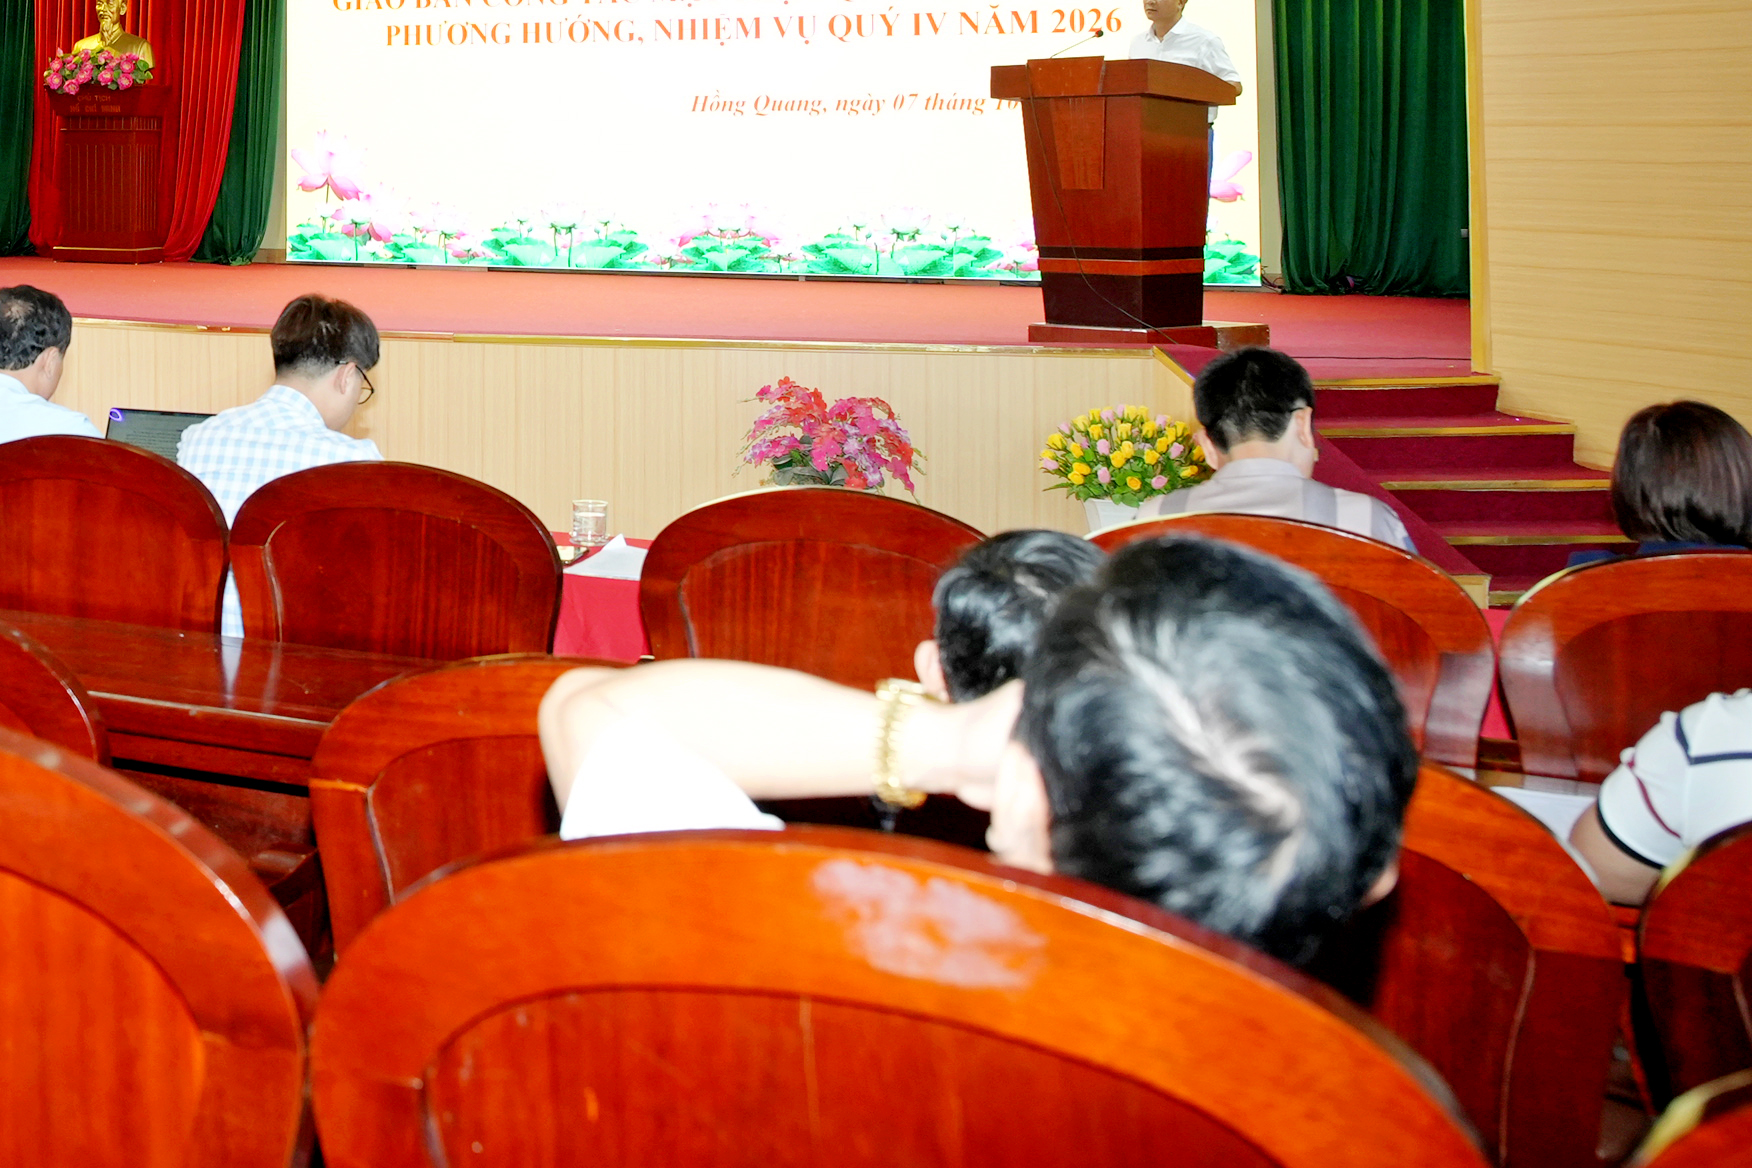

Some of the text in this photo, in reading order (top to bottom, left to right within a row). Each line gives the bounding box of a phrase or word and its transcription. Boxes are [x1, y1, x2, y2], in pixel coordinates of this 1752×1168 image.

[387, 21, 510, 46] PHƯƠNG
[523, 14, 643, 45] HƯỚNG,
[773, 16, 817, 45] VỤ
[828, 6, 899, 42] QUÝ
[914, 12, 946, 36] IV
[959, 4, 1038, 35] NĂM
[1051, 7, 1122, 33] 2026
[753, 94, 827, 116] Quang,
[835, 92, 886, 115] ngày
[893, 93, 918, 111] 07
[924, 92, 986, 115] tháng
